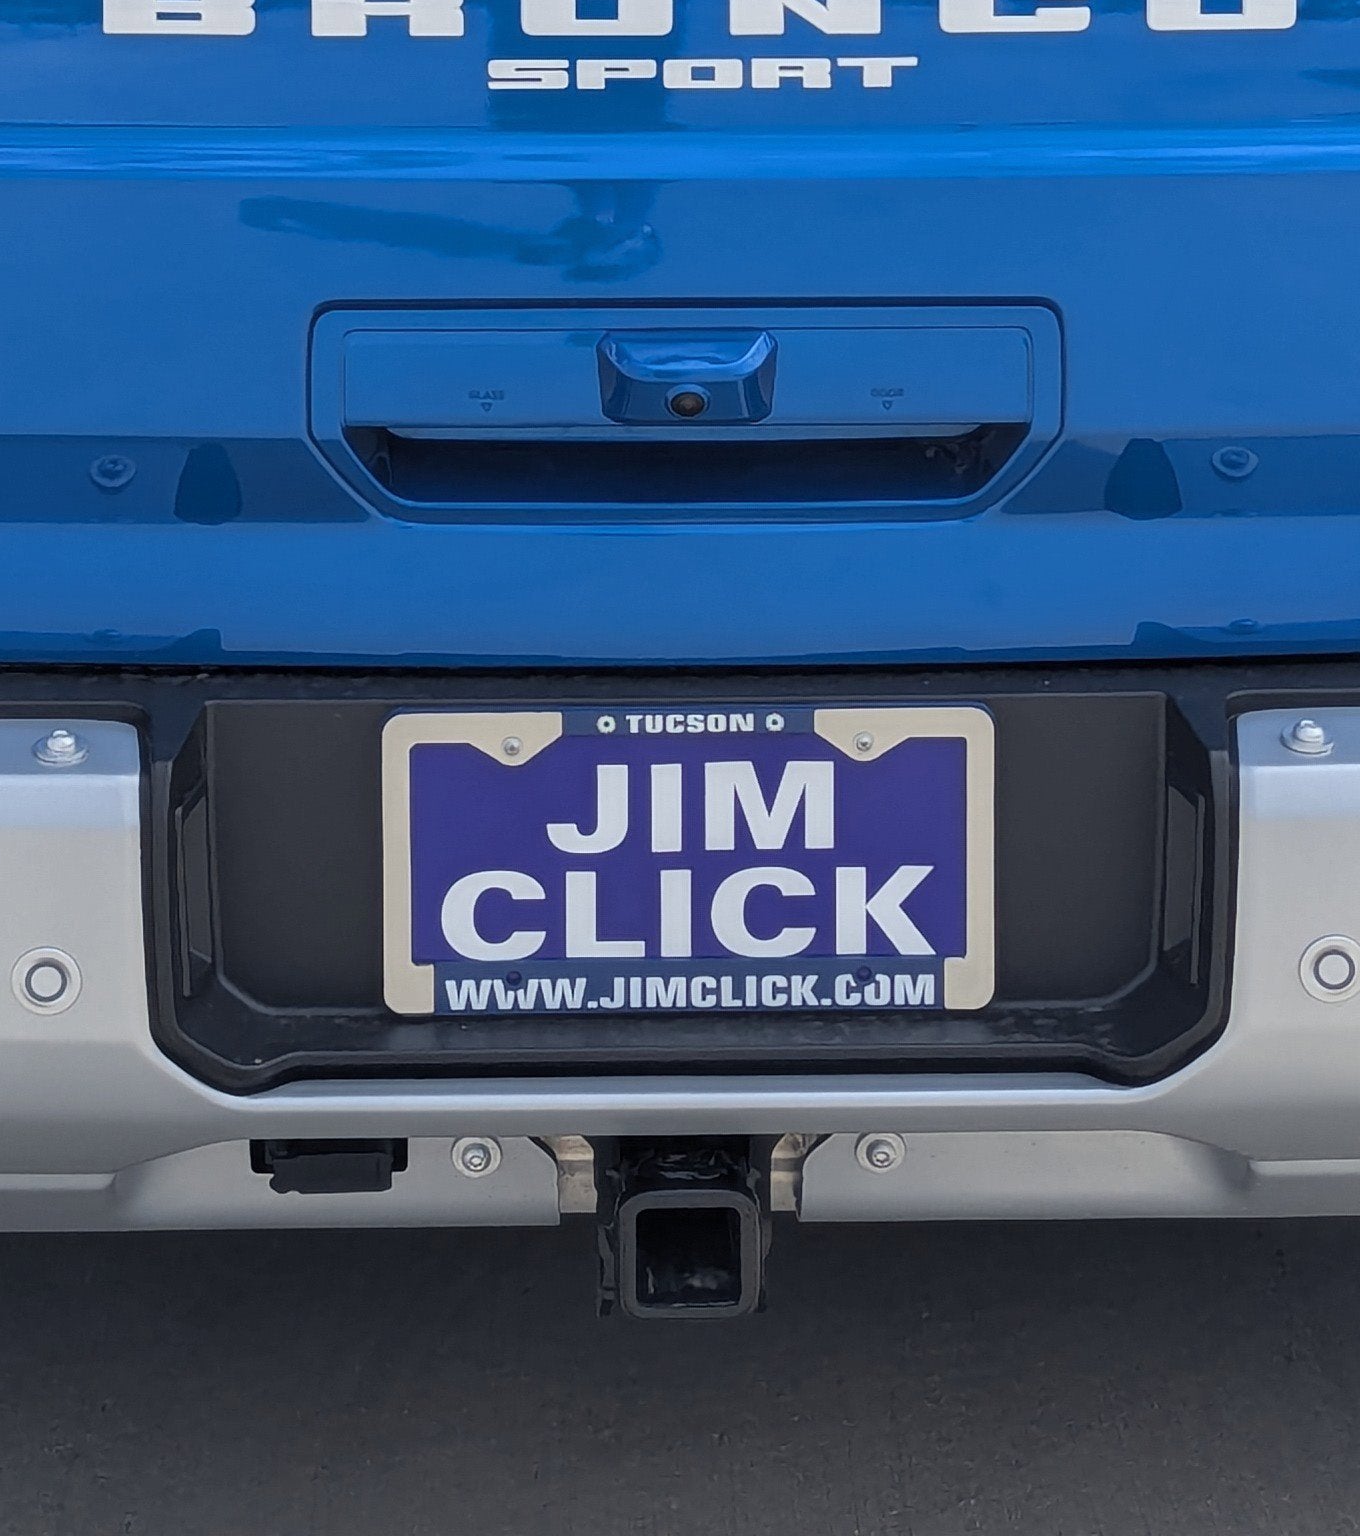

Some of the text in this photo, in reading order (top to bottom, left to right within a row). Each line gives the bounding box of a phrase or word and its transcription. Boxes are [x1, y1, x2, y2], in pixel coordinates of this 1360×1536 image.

[488, 57, 918, 89] SPORT
[626, 714, 754, 733] TUCSON
[546, 761, 834, 853] JIM
[441, 865, 936, 961] CLICK
[445, 974, 935, 1010] WWW.JIMCLICK.COM
